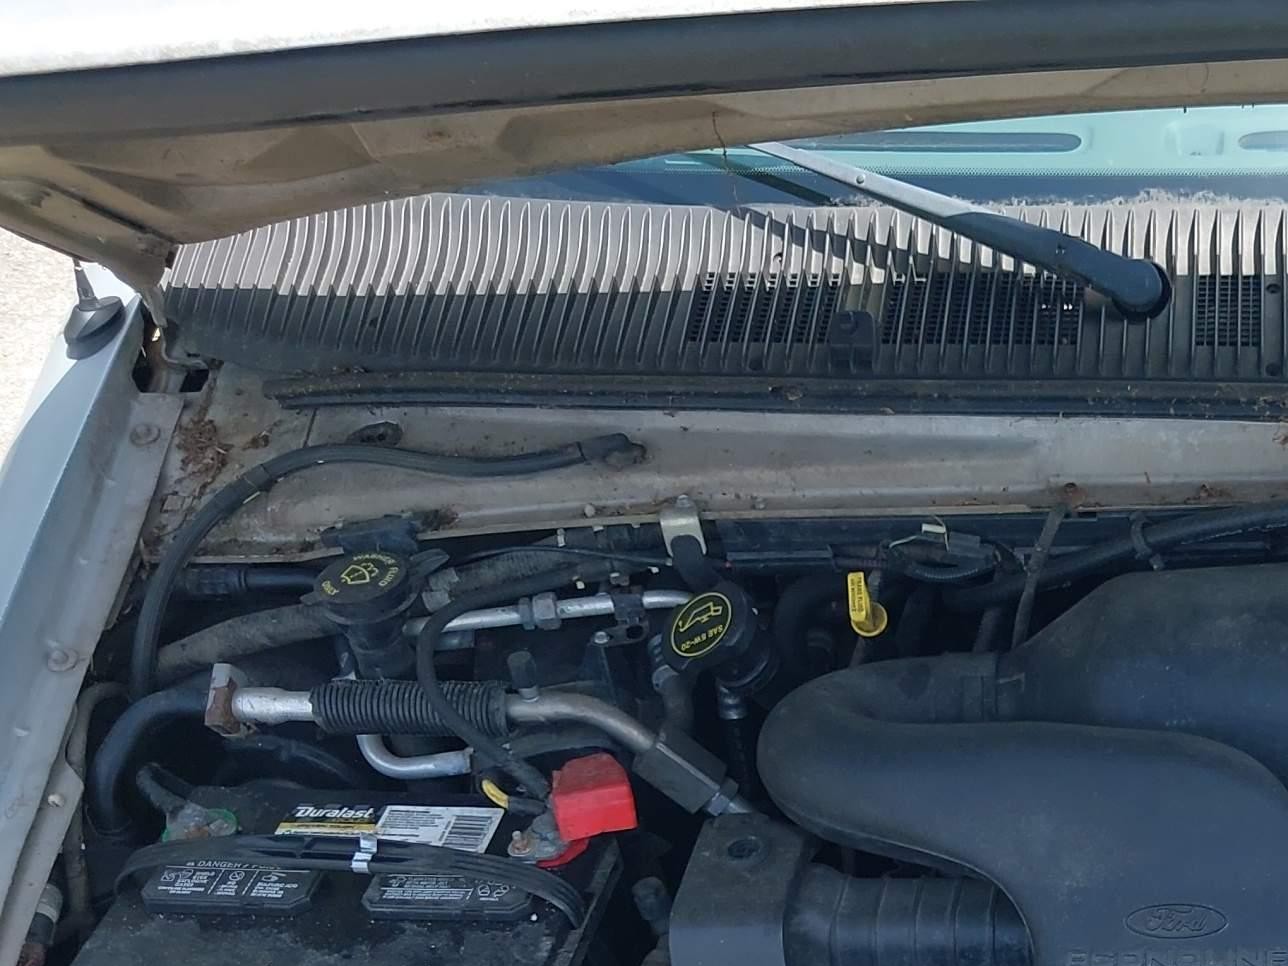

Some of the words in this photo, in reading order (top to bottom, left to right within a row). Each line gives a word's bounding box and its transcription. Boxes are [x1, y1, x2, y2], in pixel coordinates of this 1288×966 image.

[379, 567, 399, 587] FLUID
[708, 624, 724, 638] SAE
[681, 633, 707, 652] 5W-20
[294, 806, 375, 819] Duralast
[1147, 907, 1208, 931] Ford
